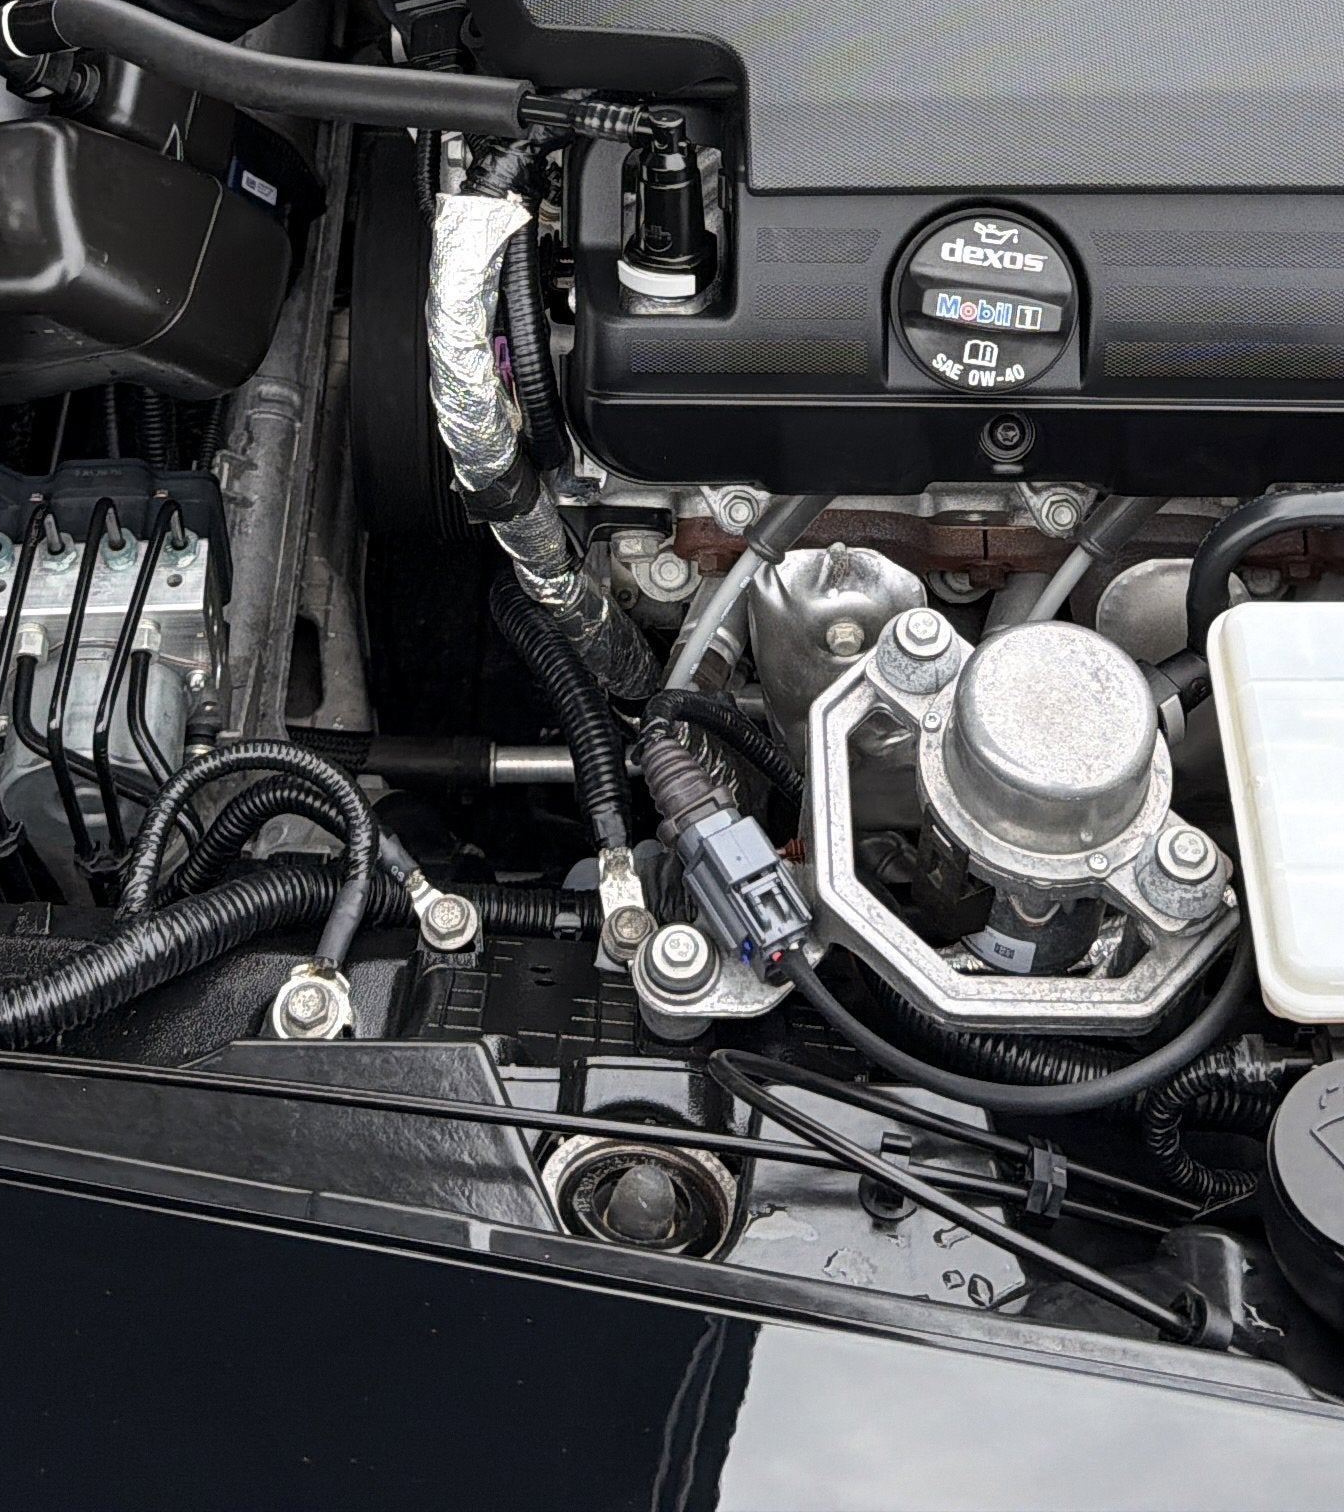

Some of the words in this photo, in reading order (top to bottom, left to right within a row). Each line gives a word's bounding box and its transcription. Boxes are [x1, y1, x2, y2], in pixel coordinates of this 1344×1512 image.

[941, 238, 1047, 272] dexos
[936, 292, 1012, 326] Mobil
[931, 353, 964, 381] SAE
[968, 363, 1025, 387] 0W-40
